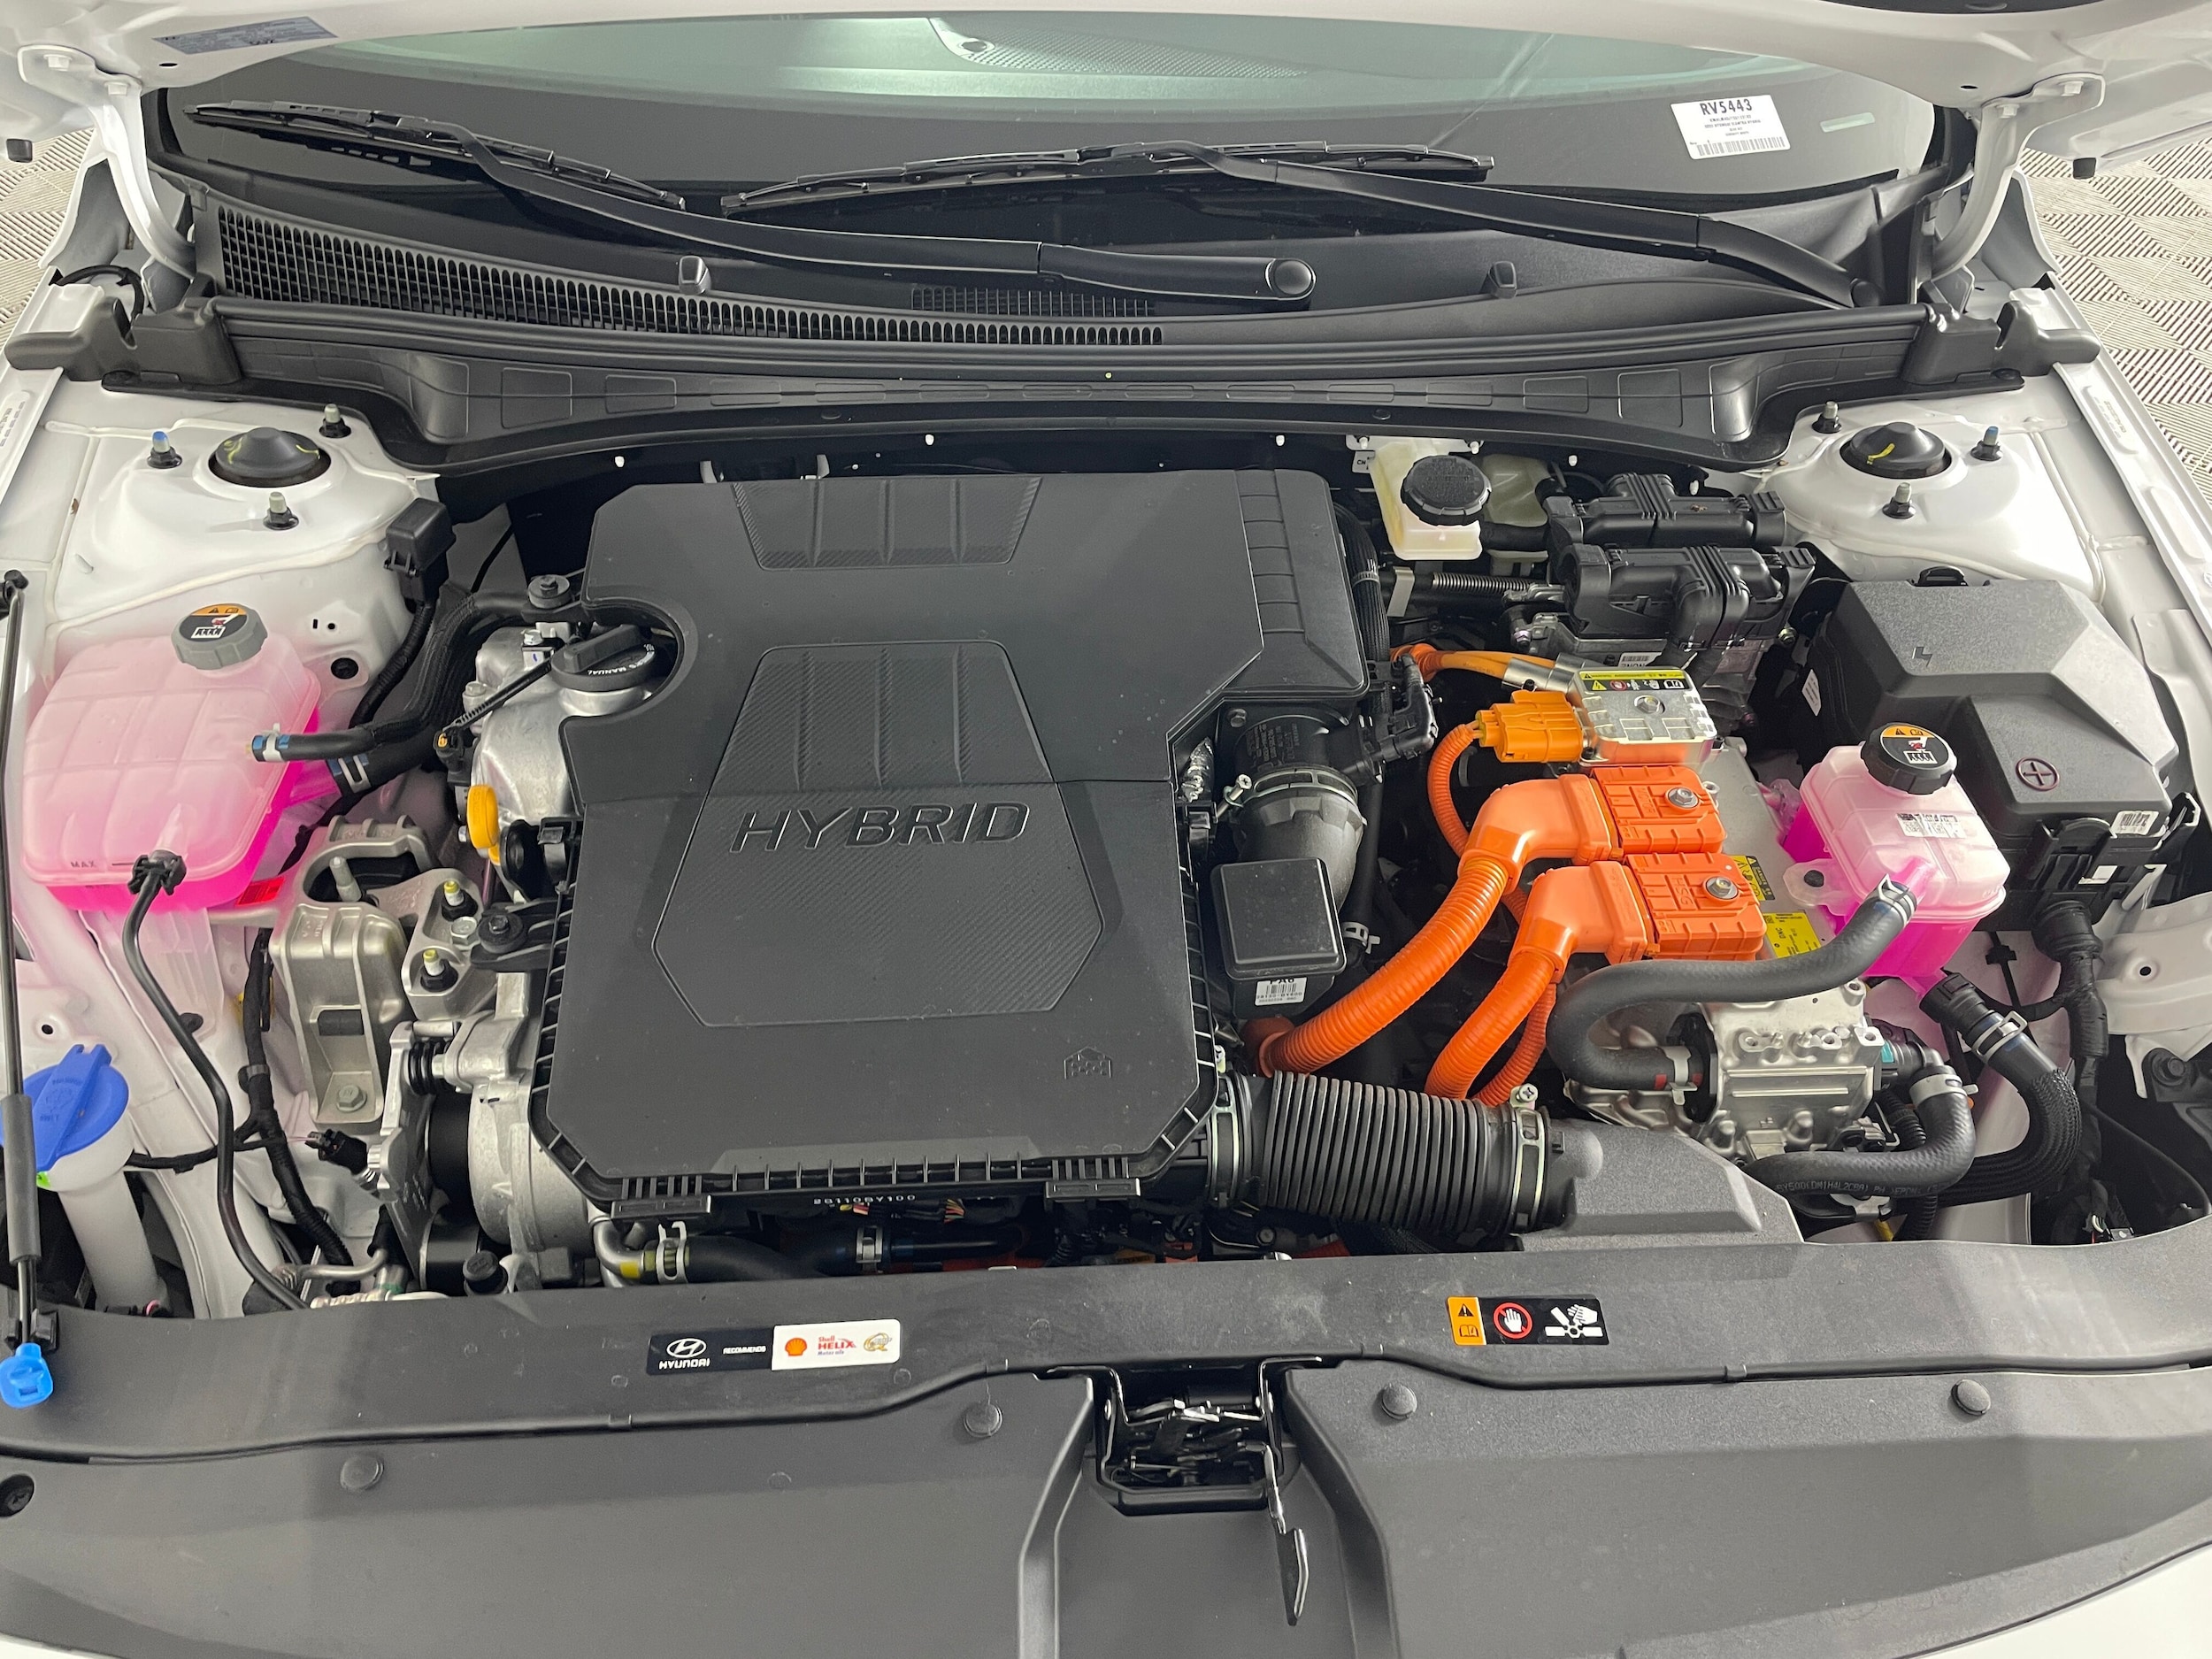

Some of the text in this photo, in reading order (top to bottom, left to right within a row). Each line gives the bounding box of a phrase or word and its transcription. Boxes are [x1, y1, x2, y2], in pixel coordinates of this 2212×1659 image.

[1699, 98, 1752, 115] RV5443
[729, 802, 1031, 853] HYBRID
[722, 1346, 767, 1355] RECOMMENDS
[818, 1340, 856, 1350] HELIX
[658, 1358, 710, 1370] HYUNDAI
